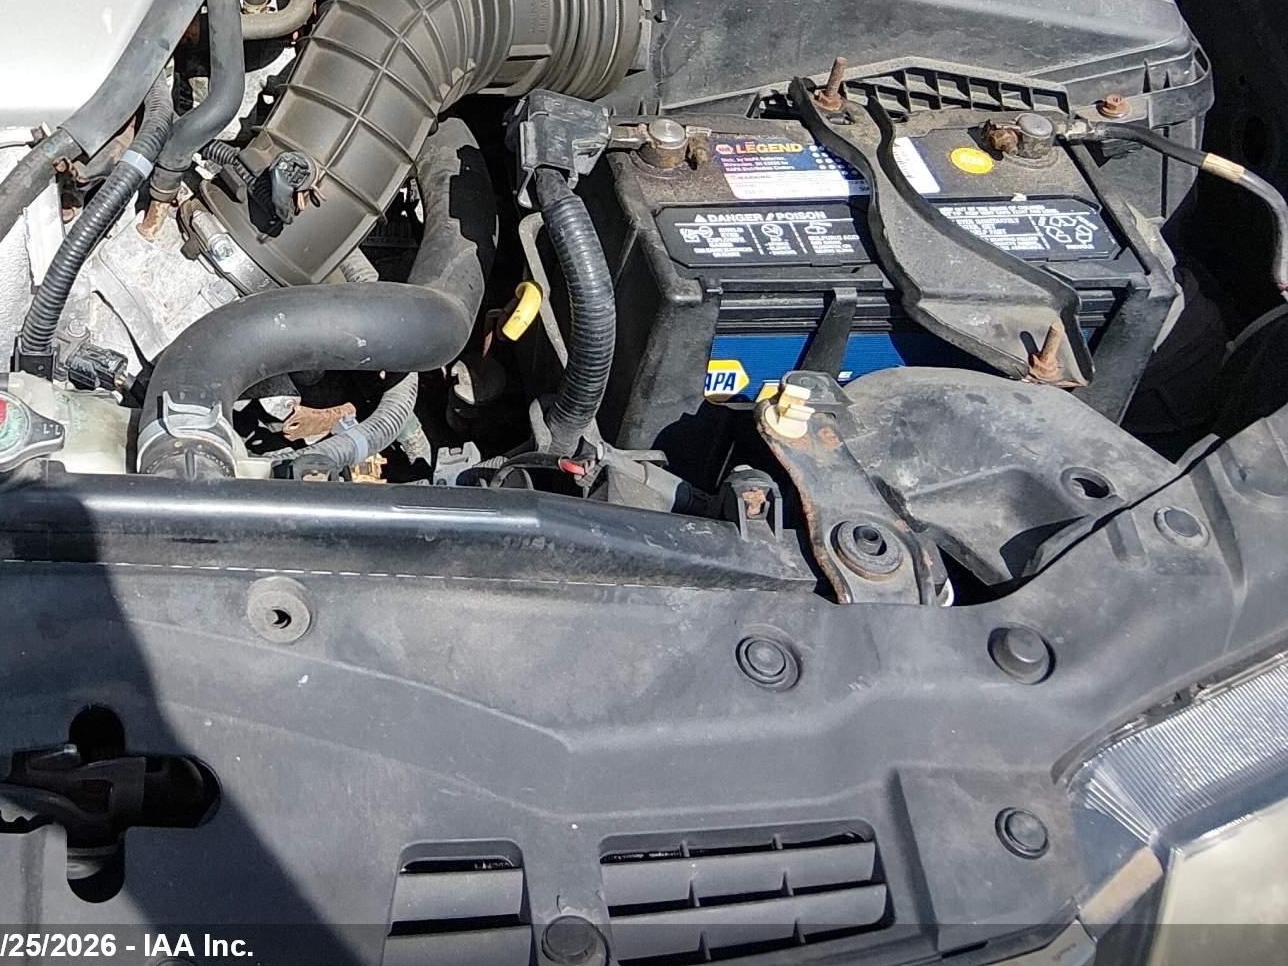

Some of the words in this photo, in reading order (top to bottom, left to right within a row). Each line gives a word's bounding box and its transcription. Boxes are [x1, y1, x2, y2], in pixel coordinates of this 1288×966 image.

[735, 142, 804, 154] LEGEND
[707, 213, 763, 223] DANGER
[774, 211, 826, 221] POISON
[704, 372, 736, 391] APA
